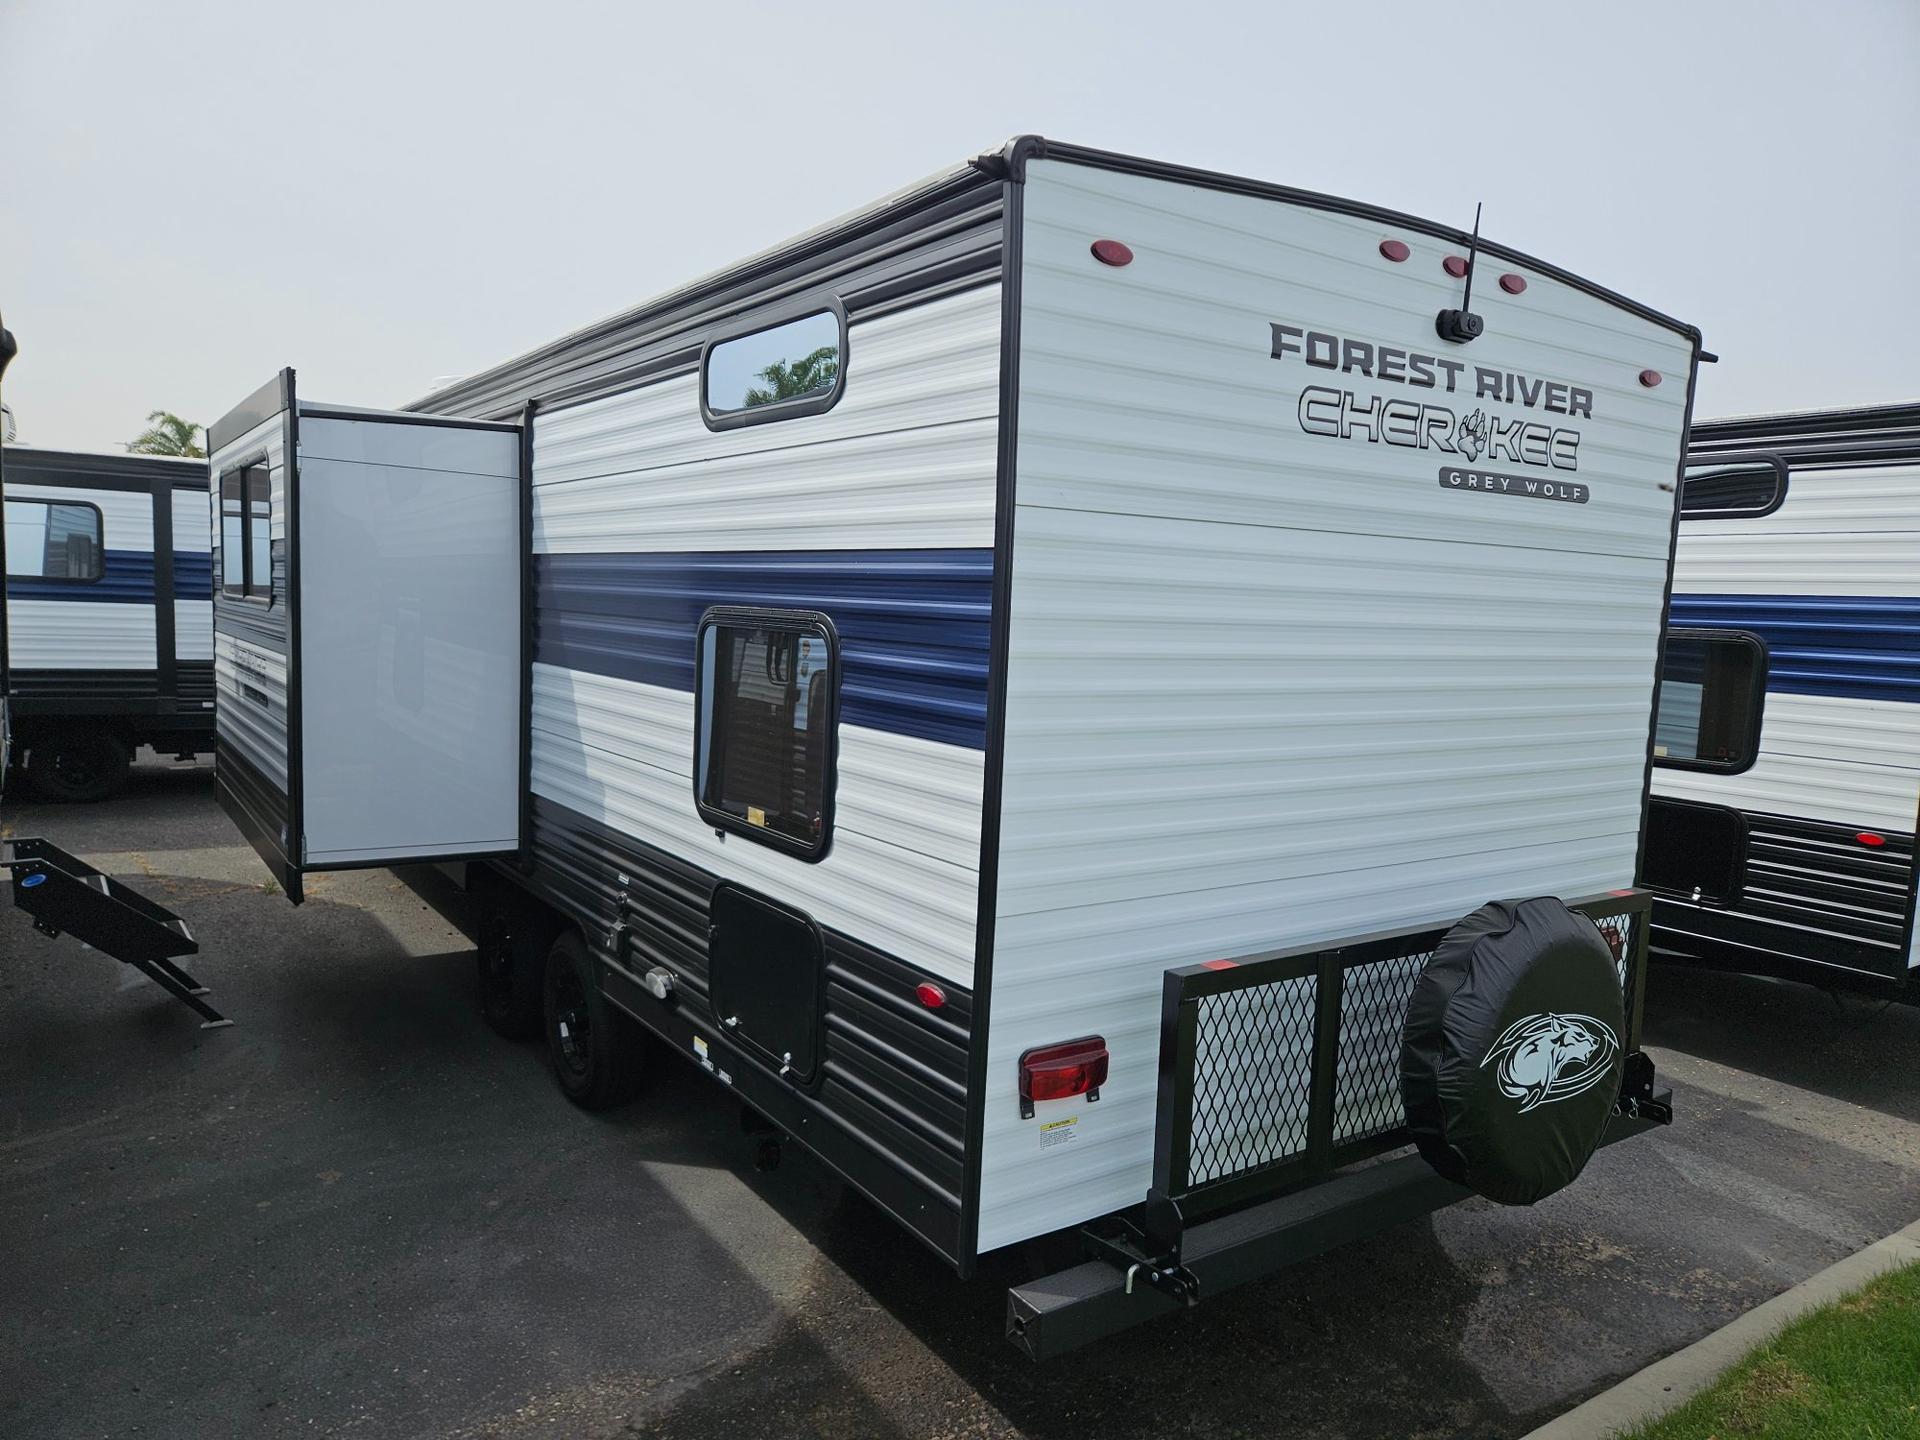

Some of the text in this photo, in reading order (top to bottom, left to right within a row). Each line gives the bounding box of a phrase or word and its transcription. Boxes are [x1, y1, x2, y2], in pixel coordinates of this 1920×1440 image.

[1269, 322, 1594, 419] FOREST RIVER
[1449, 472, 1583, 501] GREY WOLF
